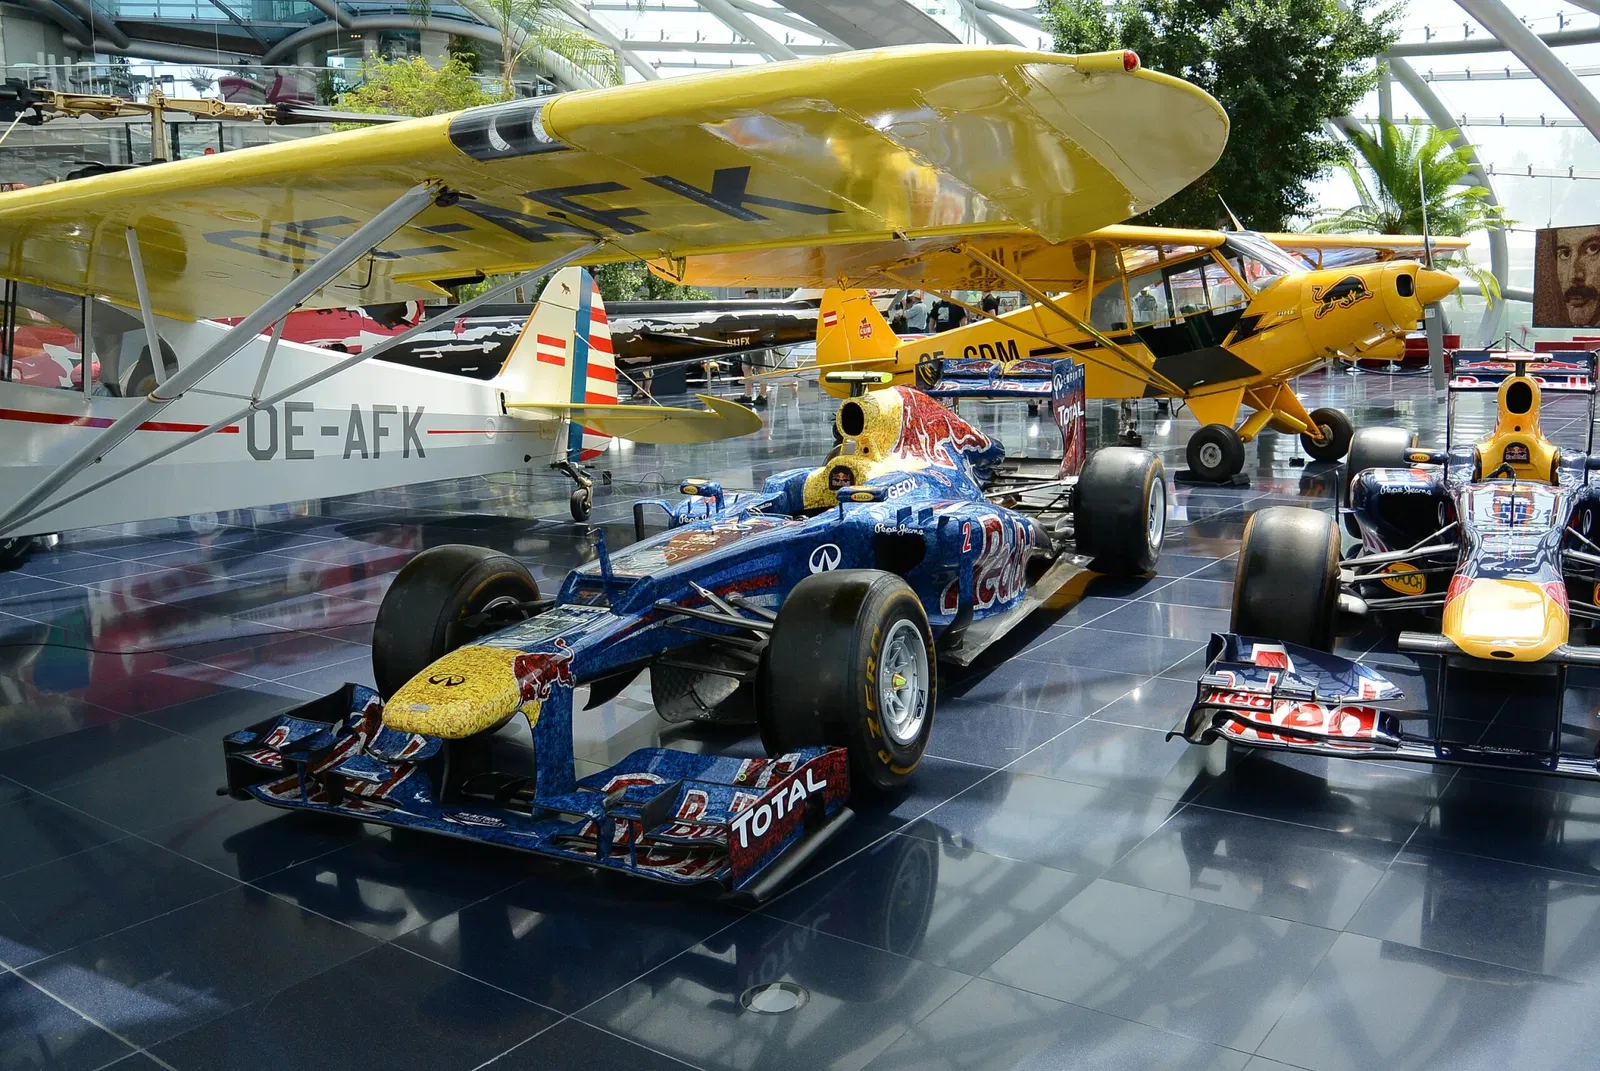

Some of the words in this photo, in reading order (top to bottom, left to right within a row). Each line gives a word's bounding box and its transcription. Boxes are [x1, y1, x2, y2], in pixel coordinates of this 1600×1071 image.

[1057, 400, 1085, 427] TOTAL
[246, 401, 426, 461] OE-AFK
[887, 477, 918, 499] GEOX
[1380, 484, 1403, 496] Pepe
[1403, 484, 1433, 496] Jeans
[874, 522, 897, 535] Pepe
[896, 523, 925, 537] Jeans
[962, 521, 972, 554] 2
[1390, 569, 1423, 590] RUCH
[731, 768, 828, 849] TOTAL
